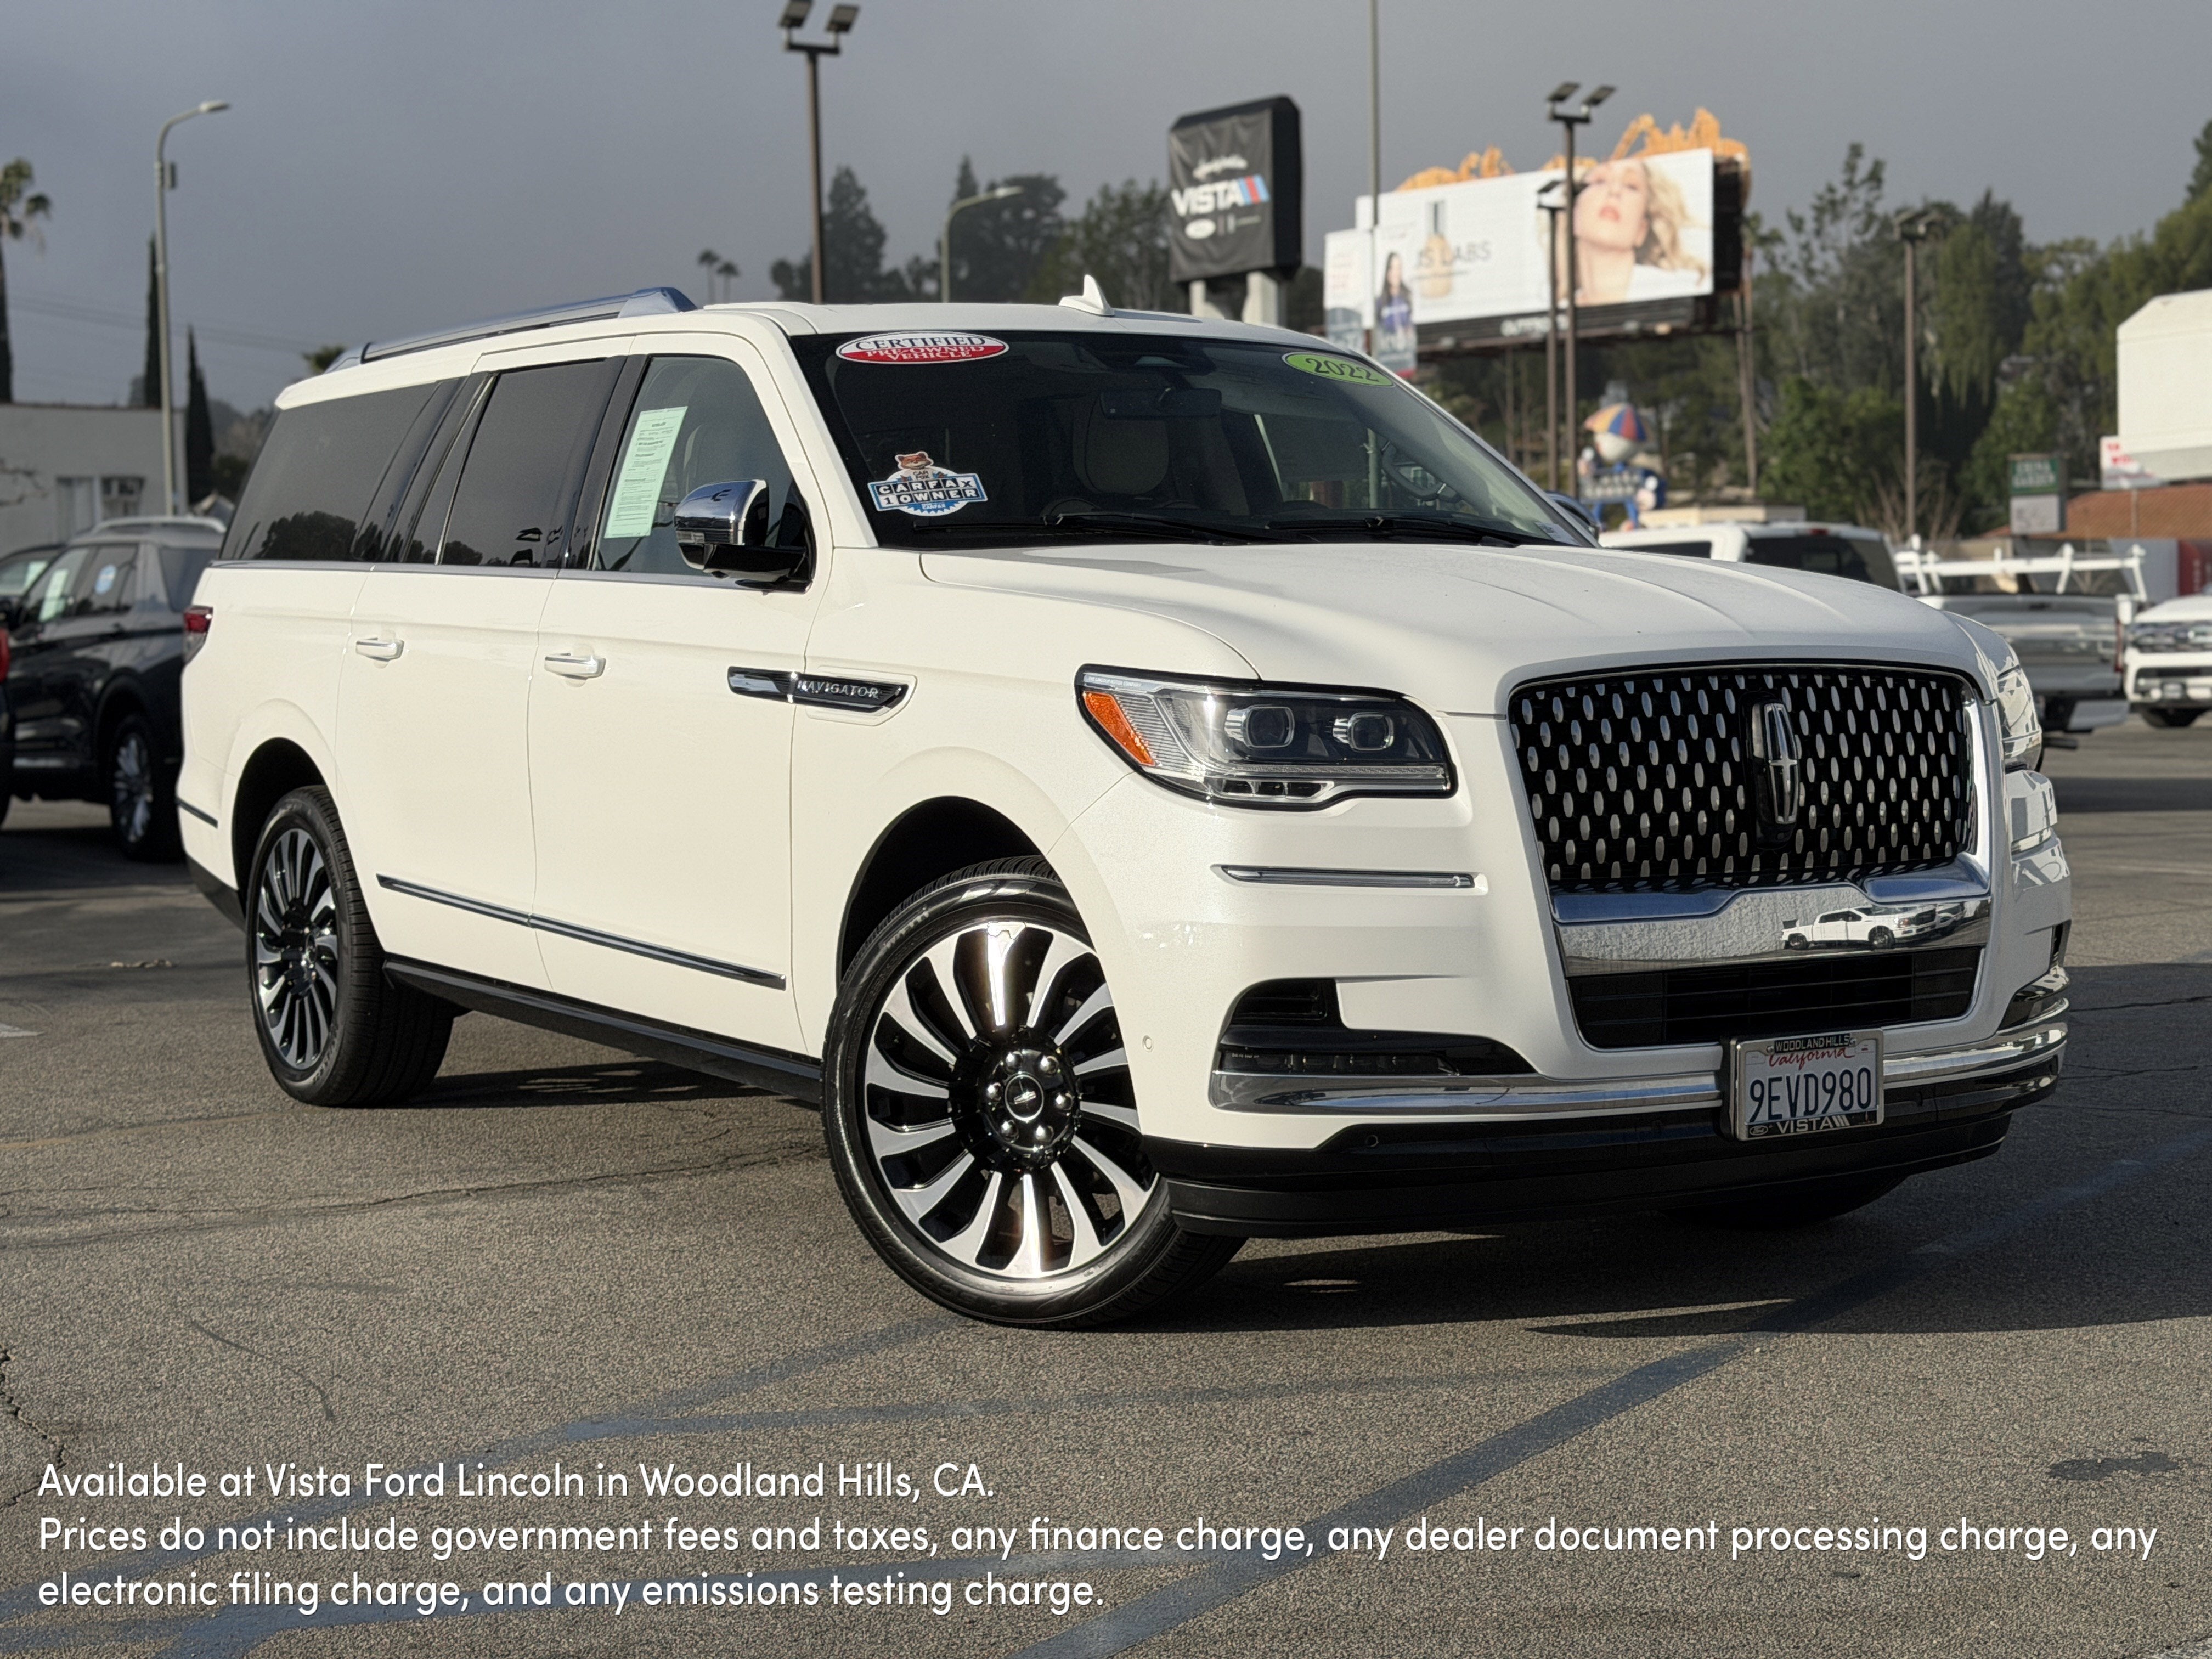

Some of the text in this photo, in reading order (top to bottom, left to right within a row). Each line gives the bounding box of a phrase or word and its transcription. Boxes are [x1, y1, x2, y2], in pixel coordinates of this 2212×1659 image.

[1171, 179, 1245, 216] VISTA
[855, 337, 985, 351] CERTIFIED
[866, 346, 985, 357] PRE-OWNED
[887, 349, 972, 360] VEHICLE
[1305, 358, 1379, 382] 2022
[878, 479, 973, 494] CARFAX
[884, 489, 978, 505] 1 OWNER
[797, 679, 879, 698] NAVIGATOR
[1775, 1035, 1850, 1051] WOODLAND HILLS
[1749, 1067, 1871, 1123] 9EVD980
[1777, 1116, 1838, 1134] VISTA
